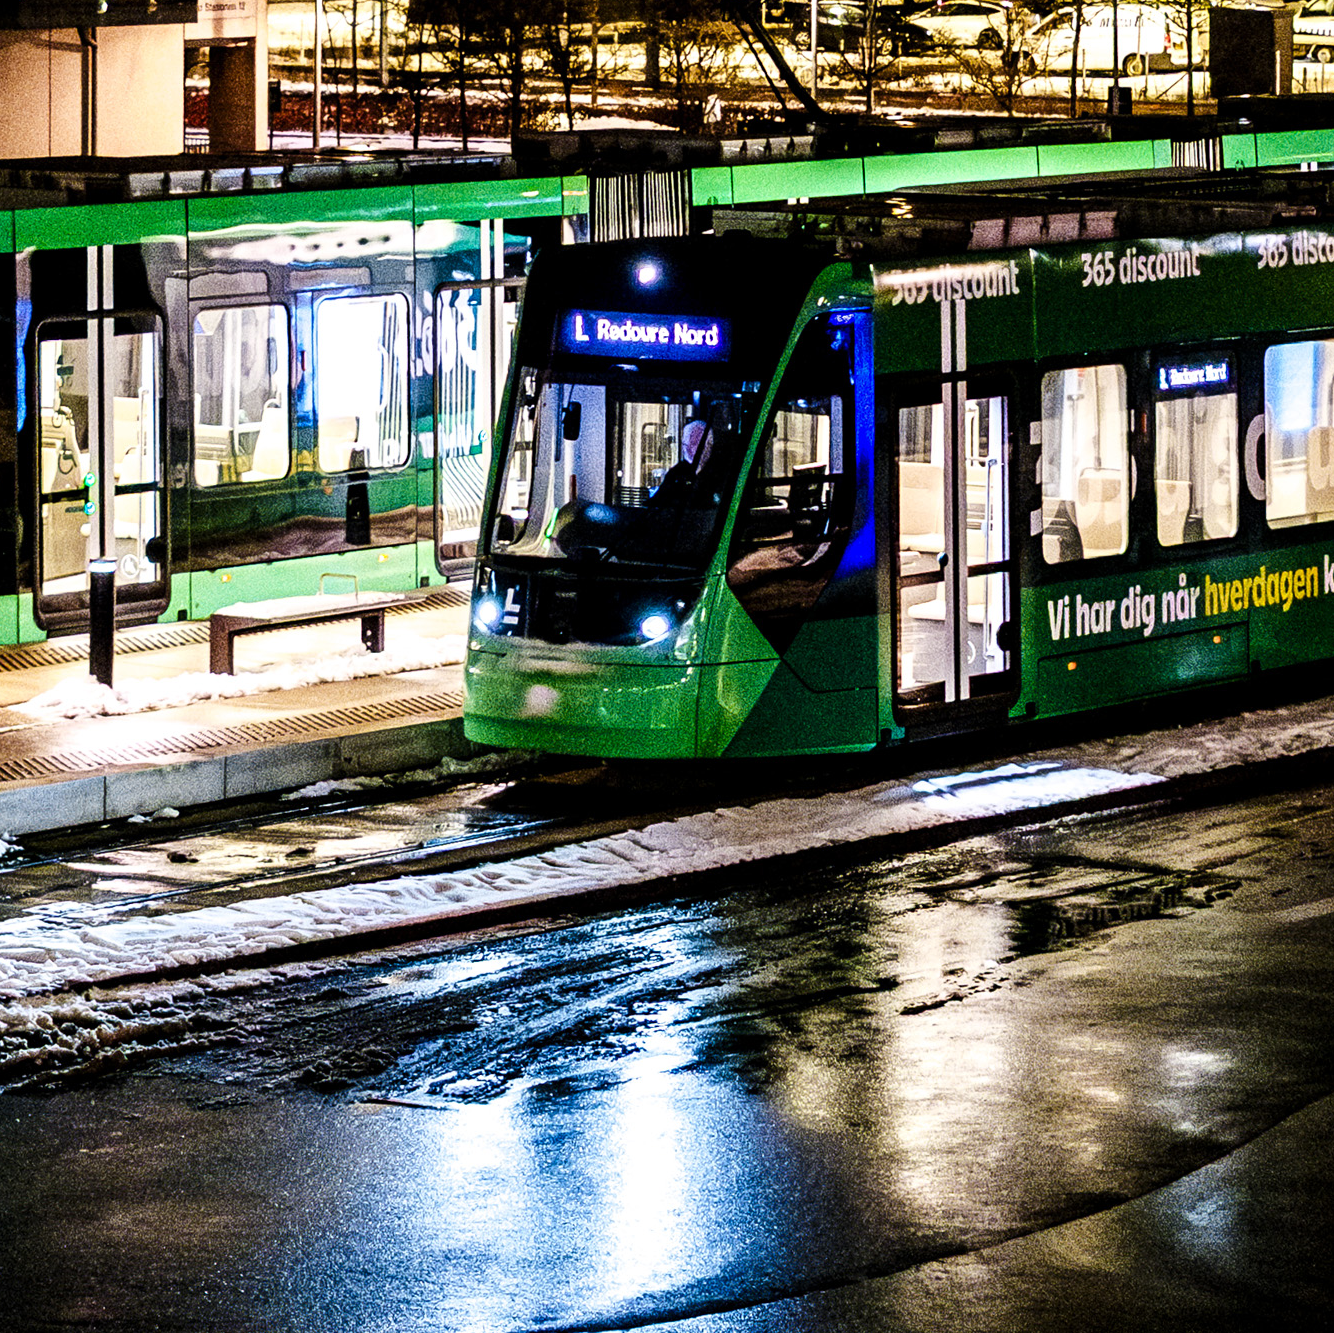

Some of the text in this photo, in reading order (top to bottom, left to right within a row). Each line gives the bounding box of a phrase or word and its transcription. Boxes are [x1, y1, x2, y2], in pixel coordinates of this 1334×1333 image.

[1081, 243, 1201, 288] 365 discount
[1257, 234, 1289, 269] 365
[932, 260, 1020, 303] discount
[575, 315, 590, 342] L
[673, 322, 719, 346] Nord
[1047, 595, 1071, 641] Vi
[1076, 593, 1116, 637] har
[1120, 584, 1156, 638] dig
[1161, 573, 1201, 624] når
[1204, 565, 1320, 617] hverdagen
